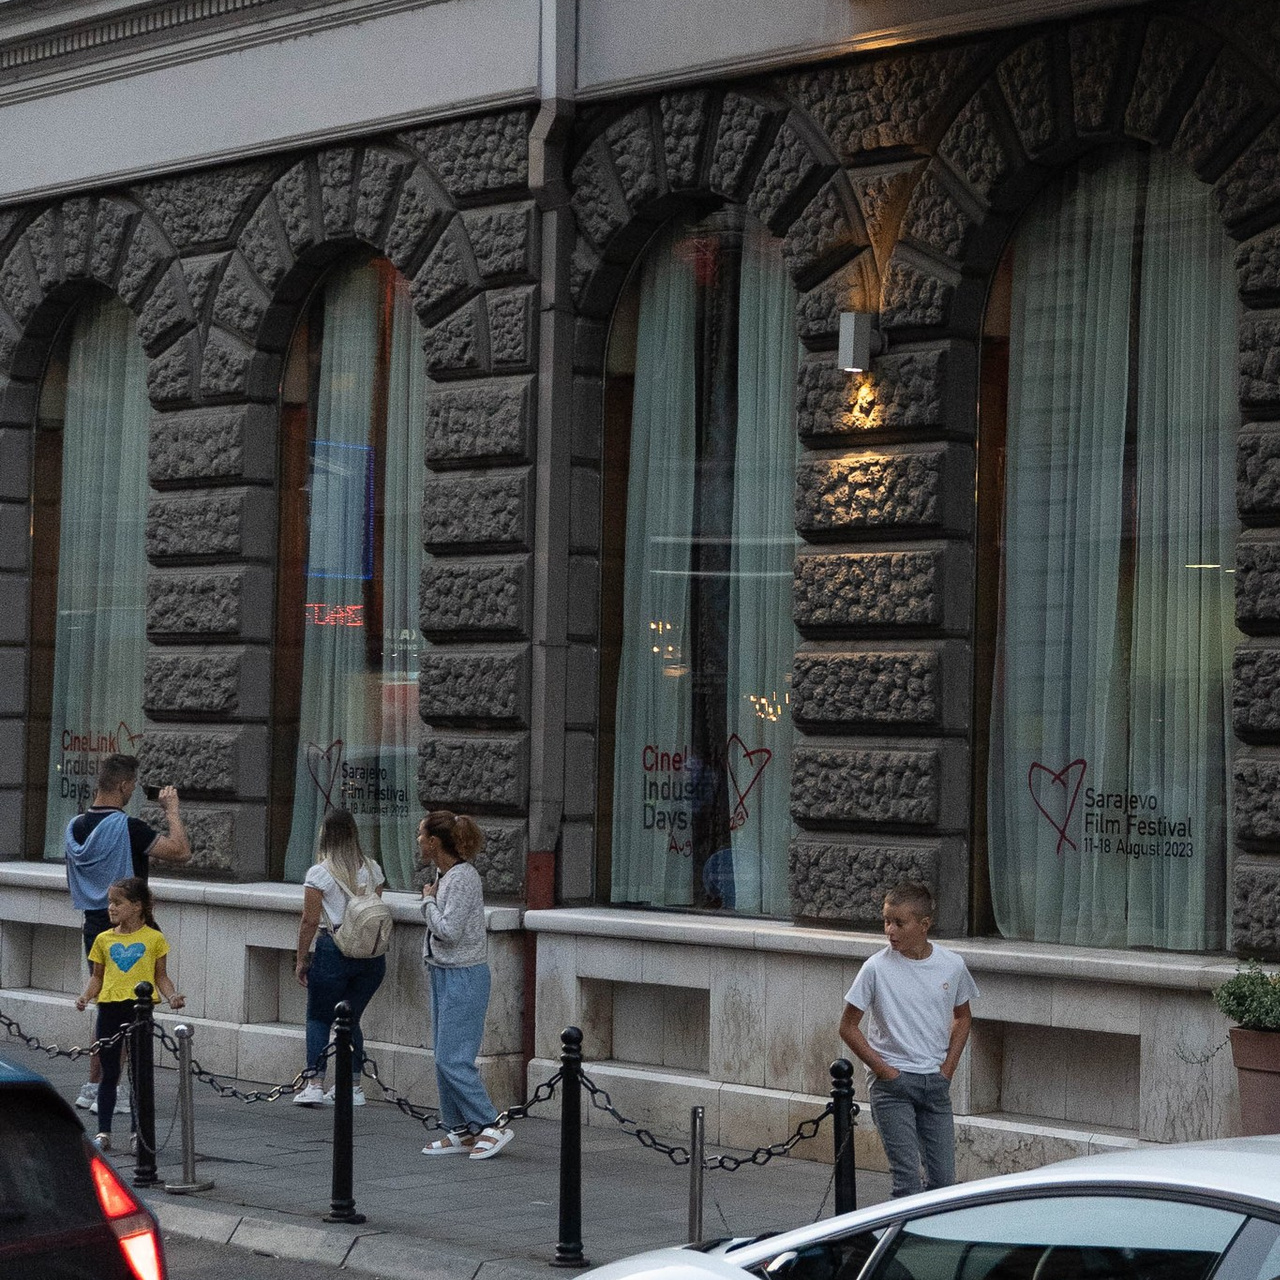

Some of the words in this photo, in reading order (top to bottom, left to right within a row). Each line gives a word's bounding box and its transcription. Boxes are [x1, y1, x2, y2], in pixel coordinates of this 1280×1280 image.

[62, 729, 116, 752] CineLink
[61, 777, 90, 803] Days
[368, 783, 408, 802] Festival
[1085, 787, 1158, 814] Sarajevo
[643, 803, 688, 837] Days
[1085, 812, 1121, 835] Film
[1127, 814, 1192, 838] Festival
[1084, 838, 1111, 854] 11-18
[1116, 839, 1160, 859] August
[1164, 841, 1194, 858] 2023
